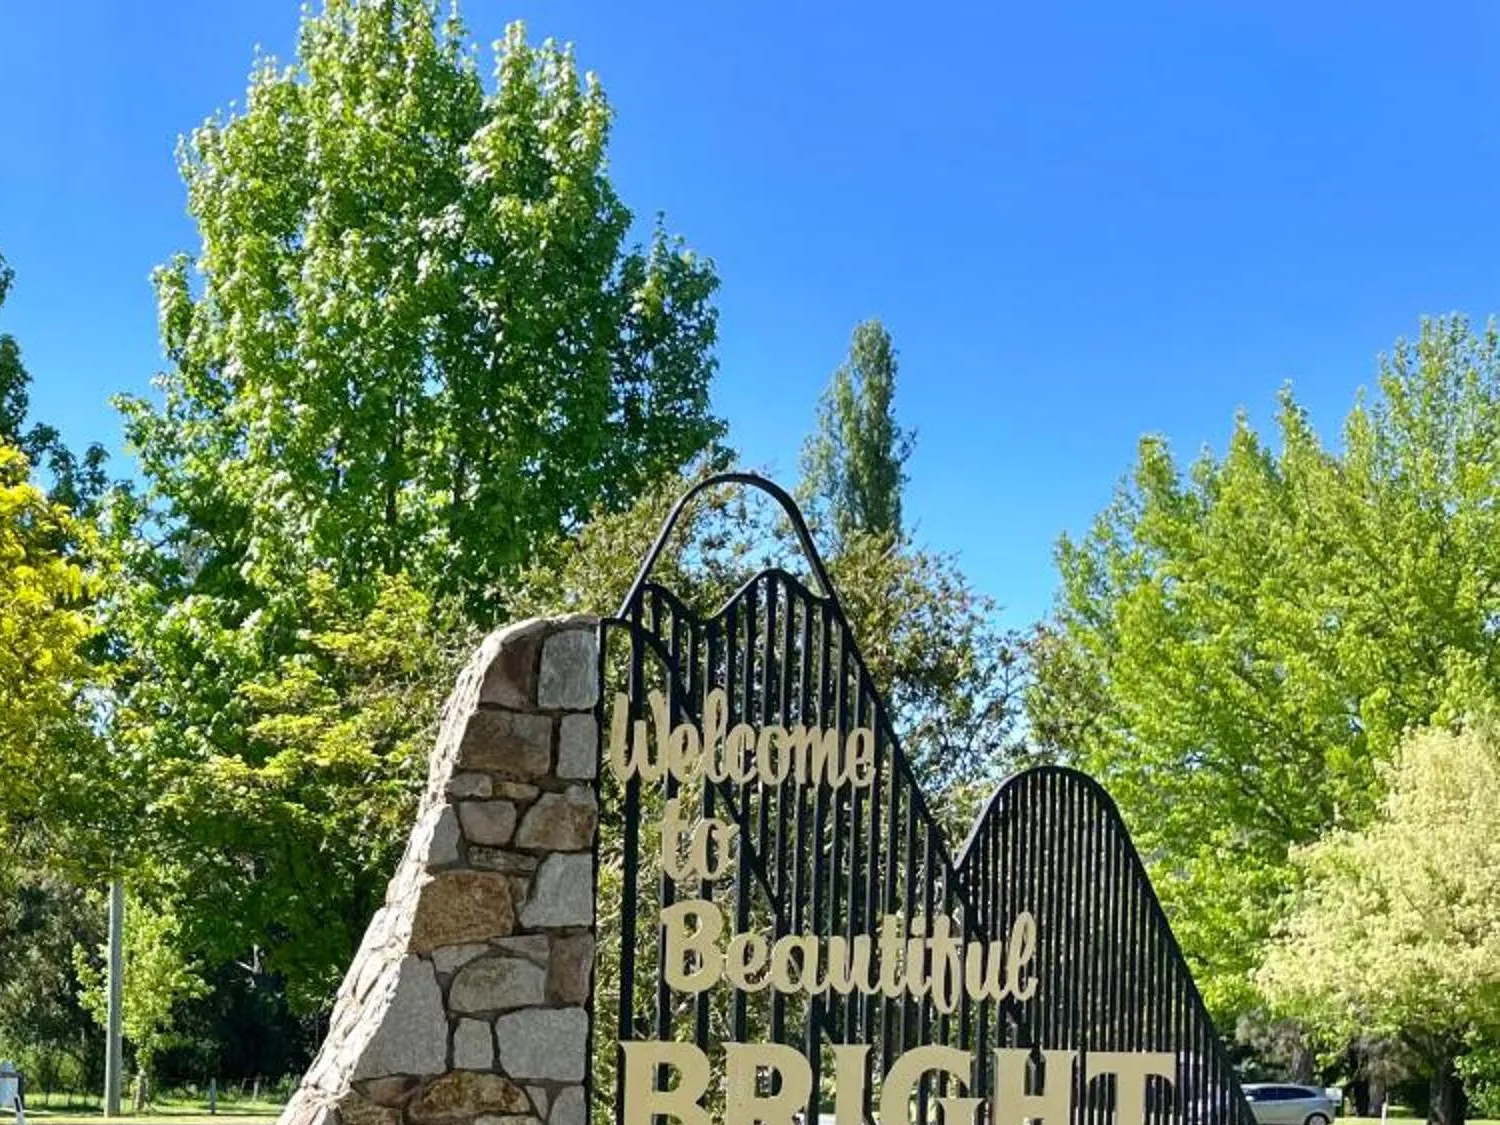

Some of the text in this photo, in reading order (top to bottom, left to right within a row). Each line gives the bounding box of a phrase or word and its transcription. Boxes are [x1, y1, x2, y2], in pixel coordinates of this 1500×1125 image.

[609, 688, 876, 787] Welcome
[657, 799, 740, 880] to
[660, 898, 1038, 1014] Beautiful
